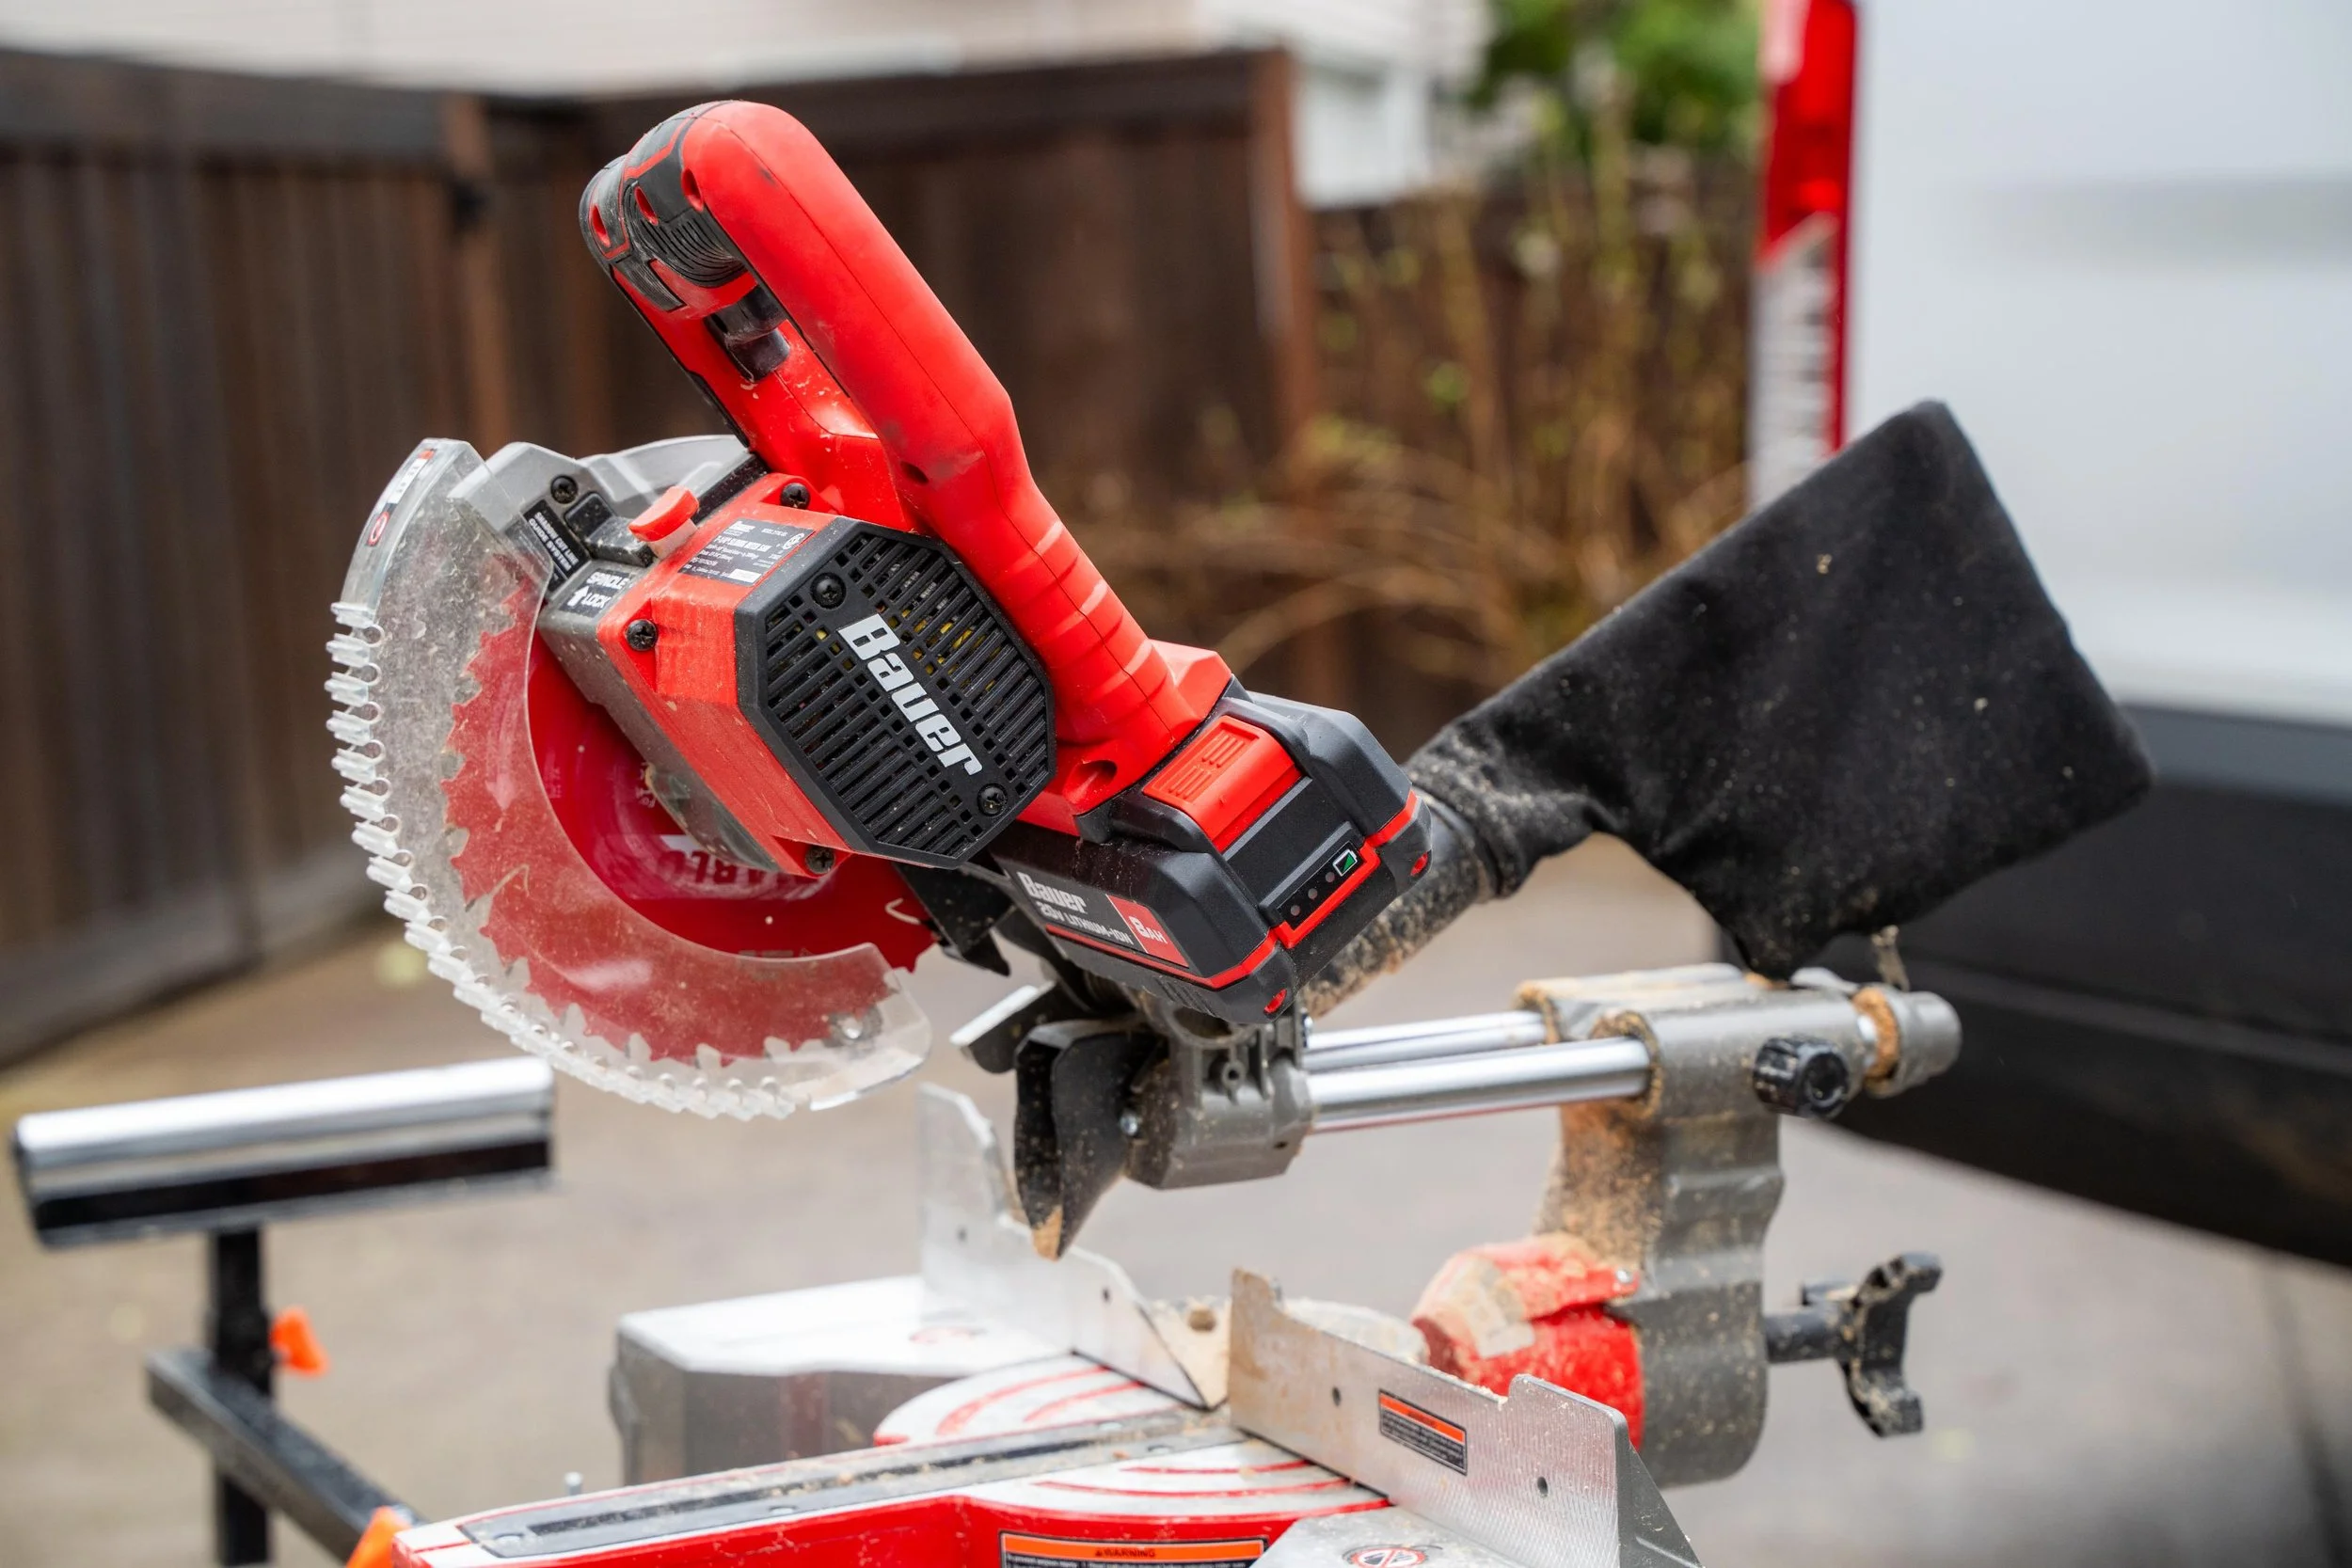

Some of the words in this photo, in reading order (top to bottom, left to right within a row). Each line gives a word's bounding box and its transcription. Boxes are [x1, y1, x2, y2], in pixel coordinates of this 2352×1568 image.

[528, 517, 549, 543] GUIDE
[546, 541, 572, 571] SYSTEM
[554, 537, 569, 552] CUT
[564, 547, 580, 565] LINE
[586, 571, 630, 590] SPINDLE
[580, 593, 612, 609] LOCK
[836, 613, 983, 776] Bauer
[1016, 871, 1088, 914] Bauer
[1063, 913, 1135, 945] LITHIUM-ION
[1103, 1547, 1156, 1559] WARNING
